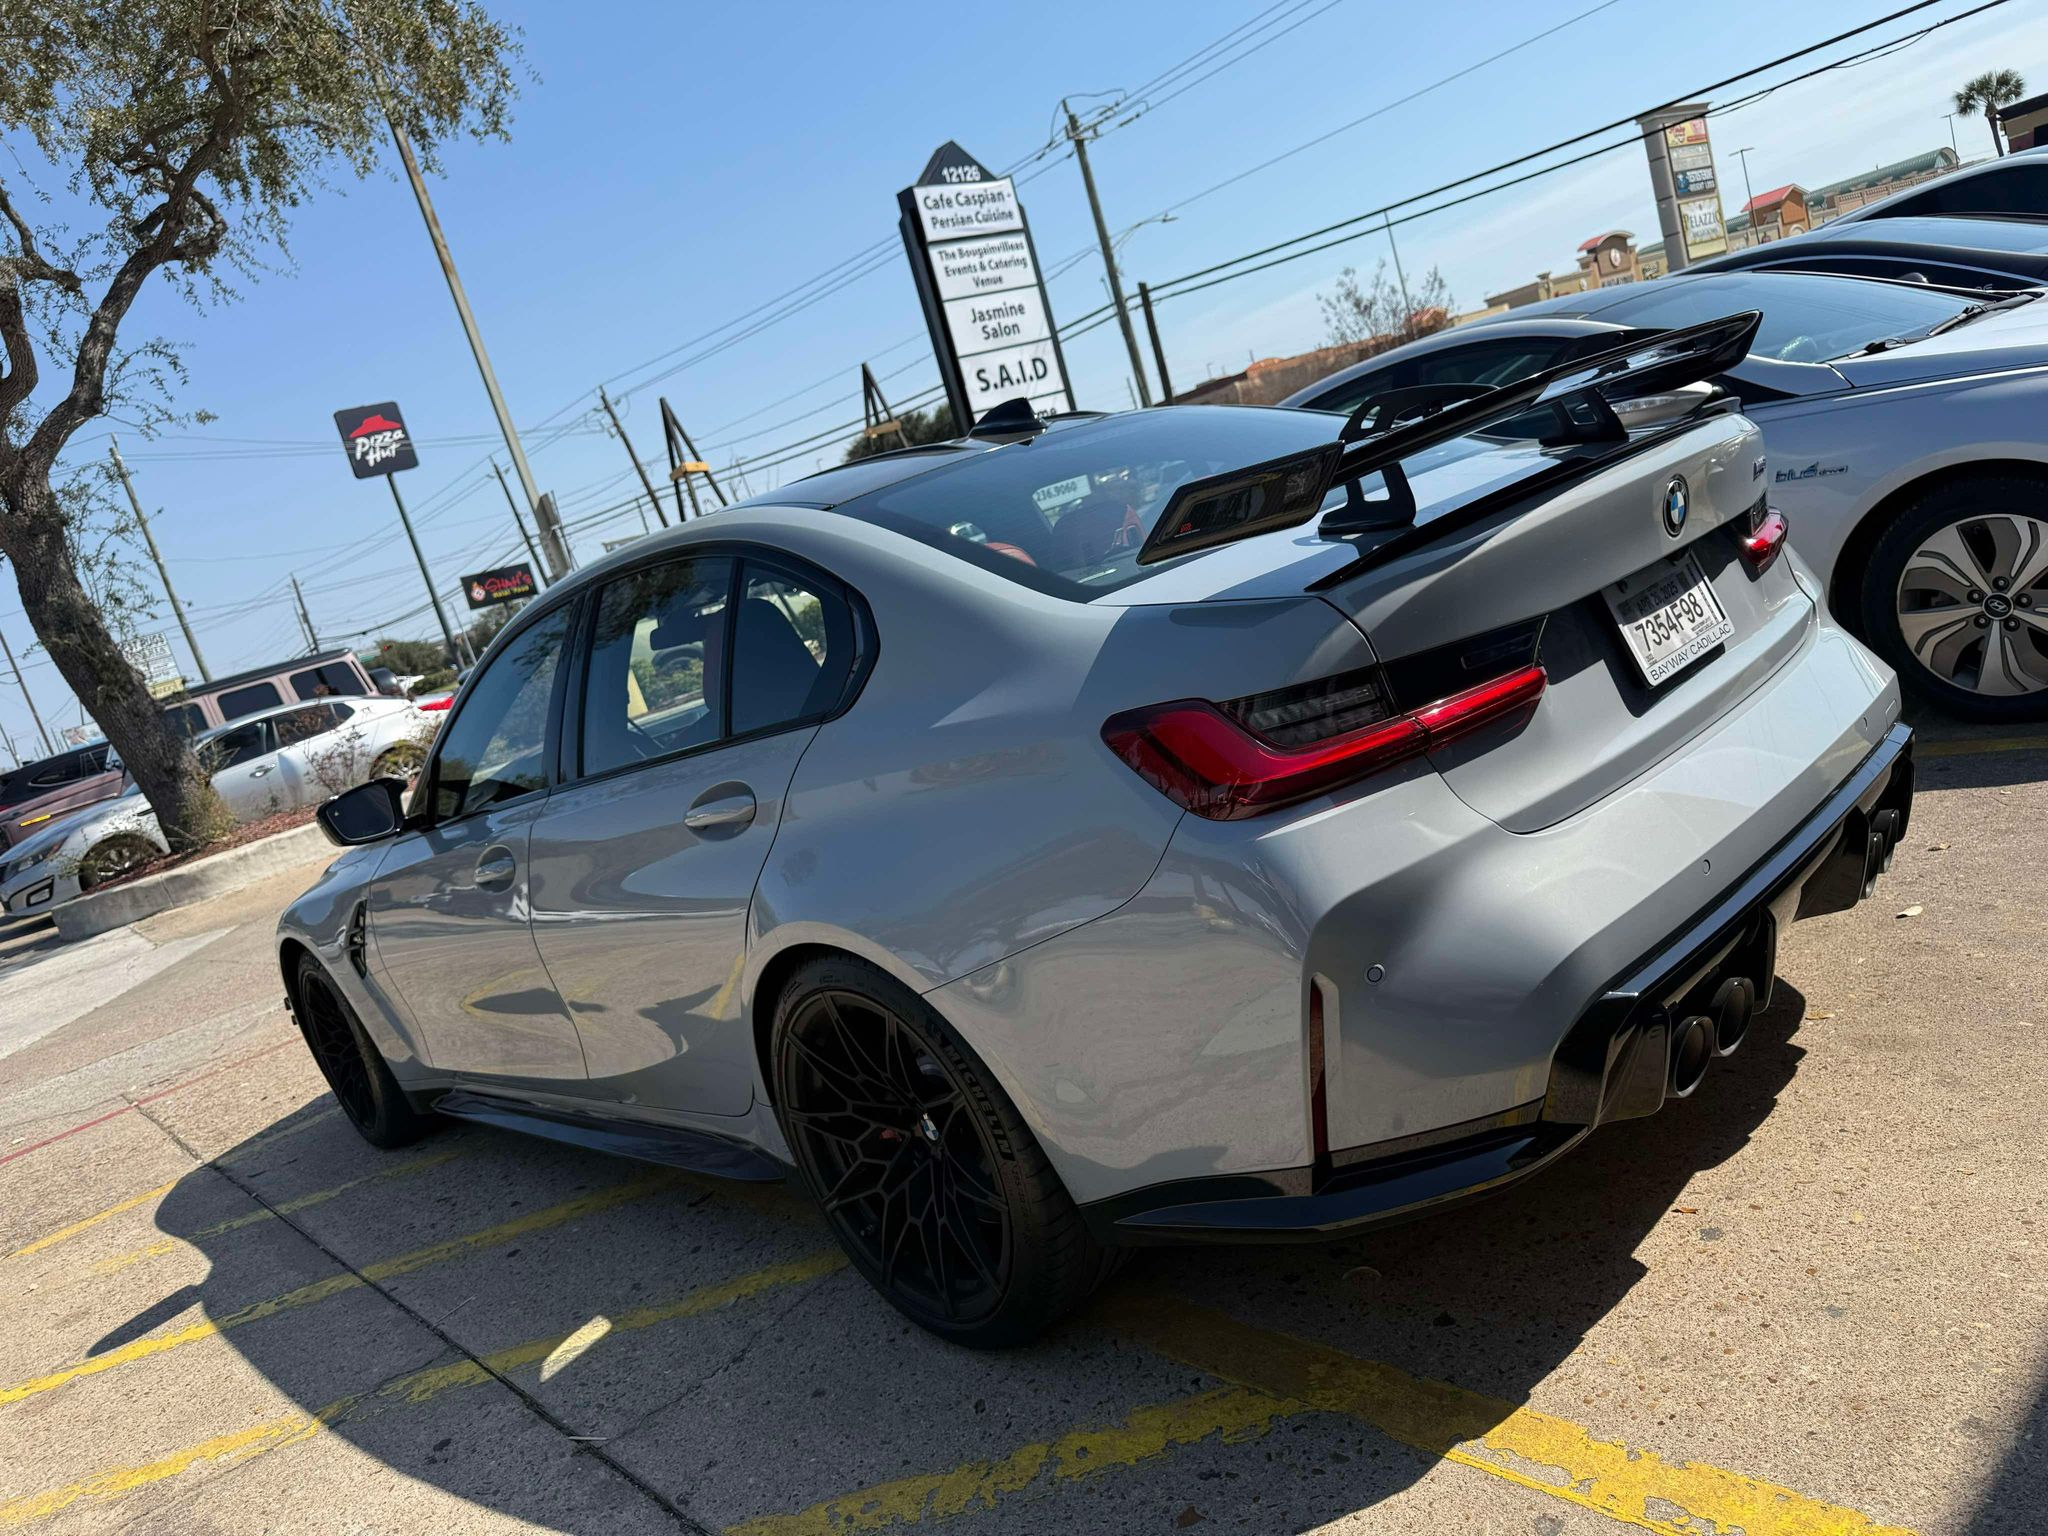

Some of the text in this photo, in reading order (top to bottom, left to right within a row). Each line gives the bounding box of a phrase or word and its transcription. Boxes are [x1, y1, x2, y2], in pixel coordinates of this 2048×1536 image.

[924, 194, 954, 210] Cafe
[955, 190, 1004, 208] Caspian
[931, 209, 1014, 229] Persian Cuisine
[937, 250, 957, 262] The
[944, 255, 1028, 278] Events & Catering
[973, 275, 1003, 288] Venue
[970, 302, 1026, 324] Jasmine
[982, 322, 1021, 341] Salon
[976, 357, 1048, 392] S.A.I.D
[354, 428, 406, 461] Pizza
[366, 442, 401, 467] Hut
[1635, 592, 1704, 652] 7354F98
[1650, 649, 1689, 681] BAYWAY
[1690, 623, 1731, 655] CADILLAC
[943, 1044, 1016, 1161] MICHELIN
